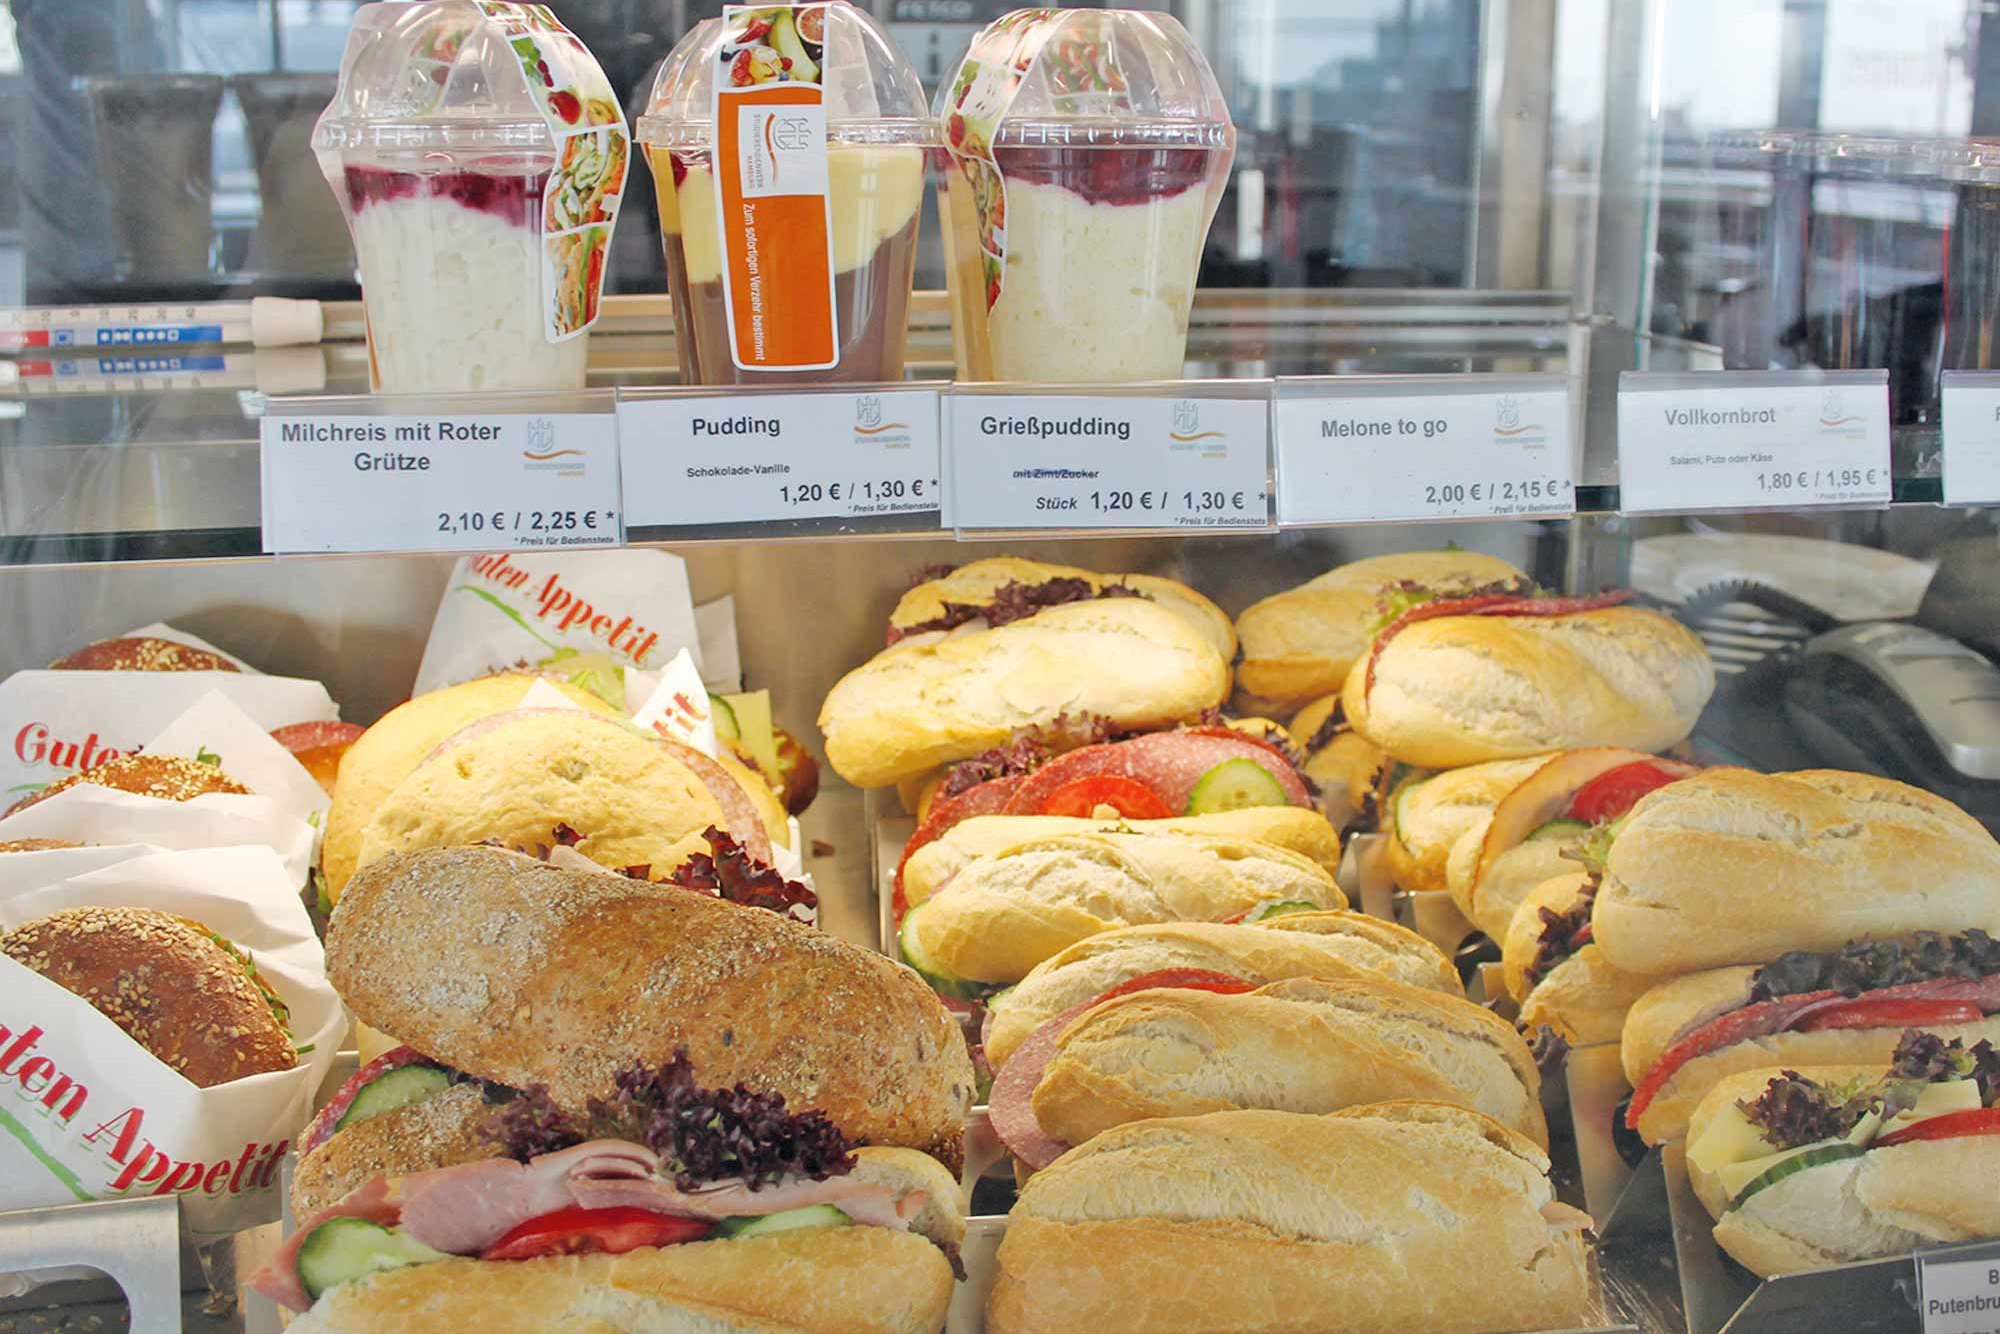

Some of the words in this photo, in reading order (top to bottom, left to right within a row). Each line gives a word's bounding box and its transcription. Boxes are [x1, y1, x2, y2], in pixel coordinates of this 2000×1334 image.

[743, 203, 755, 225] Zum
[745, 227, 760, 275] sofortigen
[750, 275, 761, 312] Verzehr
[753, 315, 766, 360] bestimmt
[692, 416, 781, 437] Pudding
[1665, 407, 1777, 427] Vollkornbrot
[281, 423, 387, 442] Milchreis
[395, 422, 432, 441] mit
[439, 422, 502, 441] Roter
[980, 416, 1131, 440] Grießpudding
[1321, 419, 1393, 438] Melone
[1398, 418, 1417, 436] to
[1423, 419, 1448, 438] go
[354, 452, 431, 472] Grütze
[687, 463, 791, 478] Schokolade-Vanille
[1757, 471, 1792, 492] 1,80
[1797, 471, 1808, 488] €
[1826, 469, 1862, 490] 1,95
[1866, 468, 1877, 485] €
[780, 483, 822, 505] 1,20
[828, 483, 841, 501] €
[863, 480, 905, 501] 1,30
[911, 479, 924, 497] €
[1035, 495, 1078, 511] Stück
[1090, 491, 1133, 512] 1,20
[1139, 491, 1153, 510] €
[1183, 491, 1225, 512] 1,30
[1231, 491, 1244, 510] €
[1425, 485, 1464, 506] 2,00
[1469, 484, 1482, 501] €
[1503, 481, 1541, 502] 2,15
[1546, 480, 1558, 497] €
[853, 504, 875, 513] Preis
[438, 512, 485, 534] 2,10
[491, 511, 505, 530] €
[531, 511, 577, 533] 2,25
[584, 510, 597, 529] €
[1179, 516, 1201, 525] Preis
[520, 536, 543, 546] Preis
[545, 536, 559, 545] für
[525, 573, 660, 664] Appetit
[82, 1106, 290, 1196] Appetit
[1929, 1296, 2000, 1315] Putenbru
